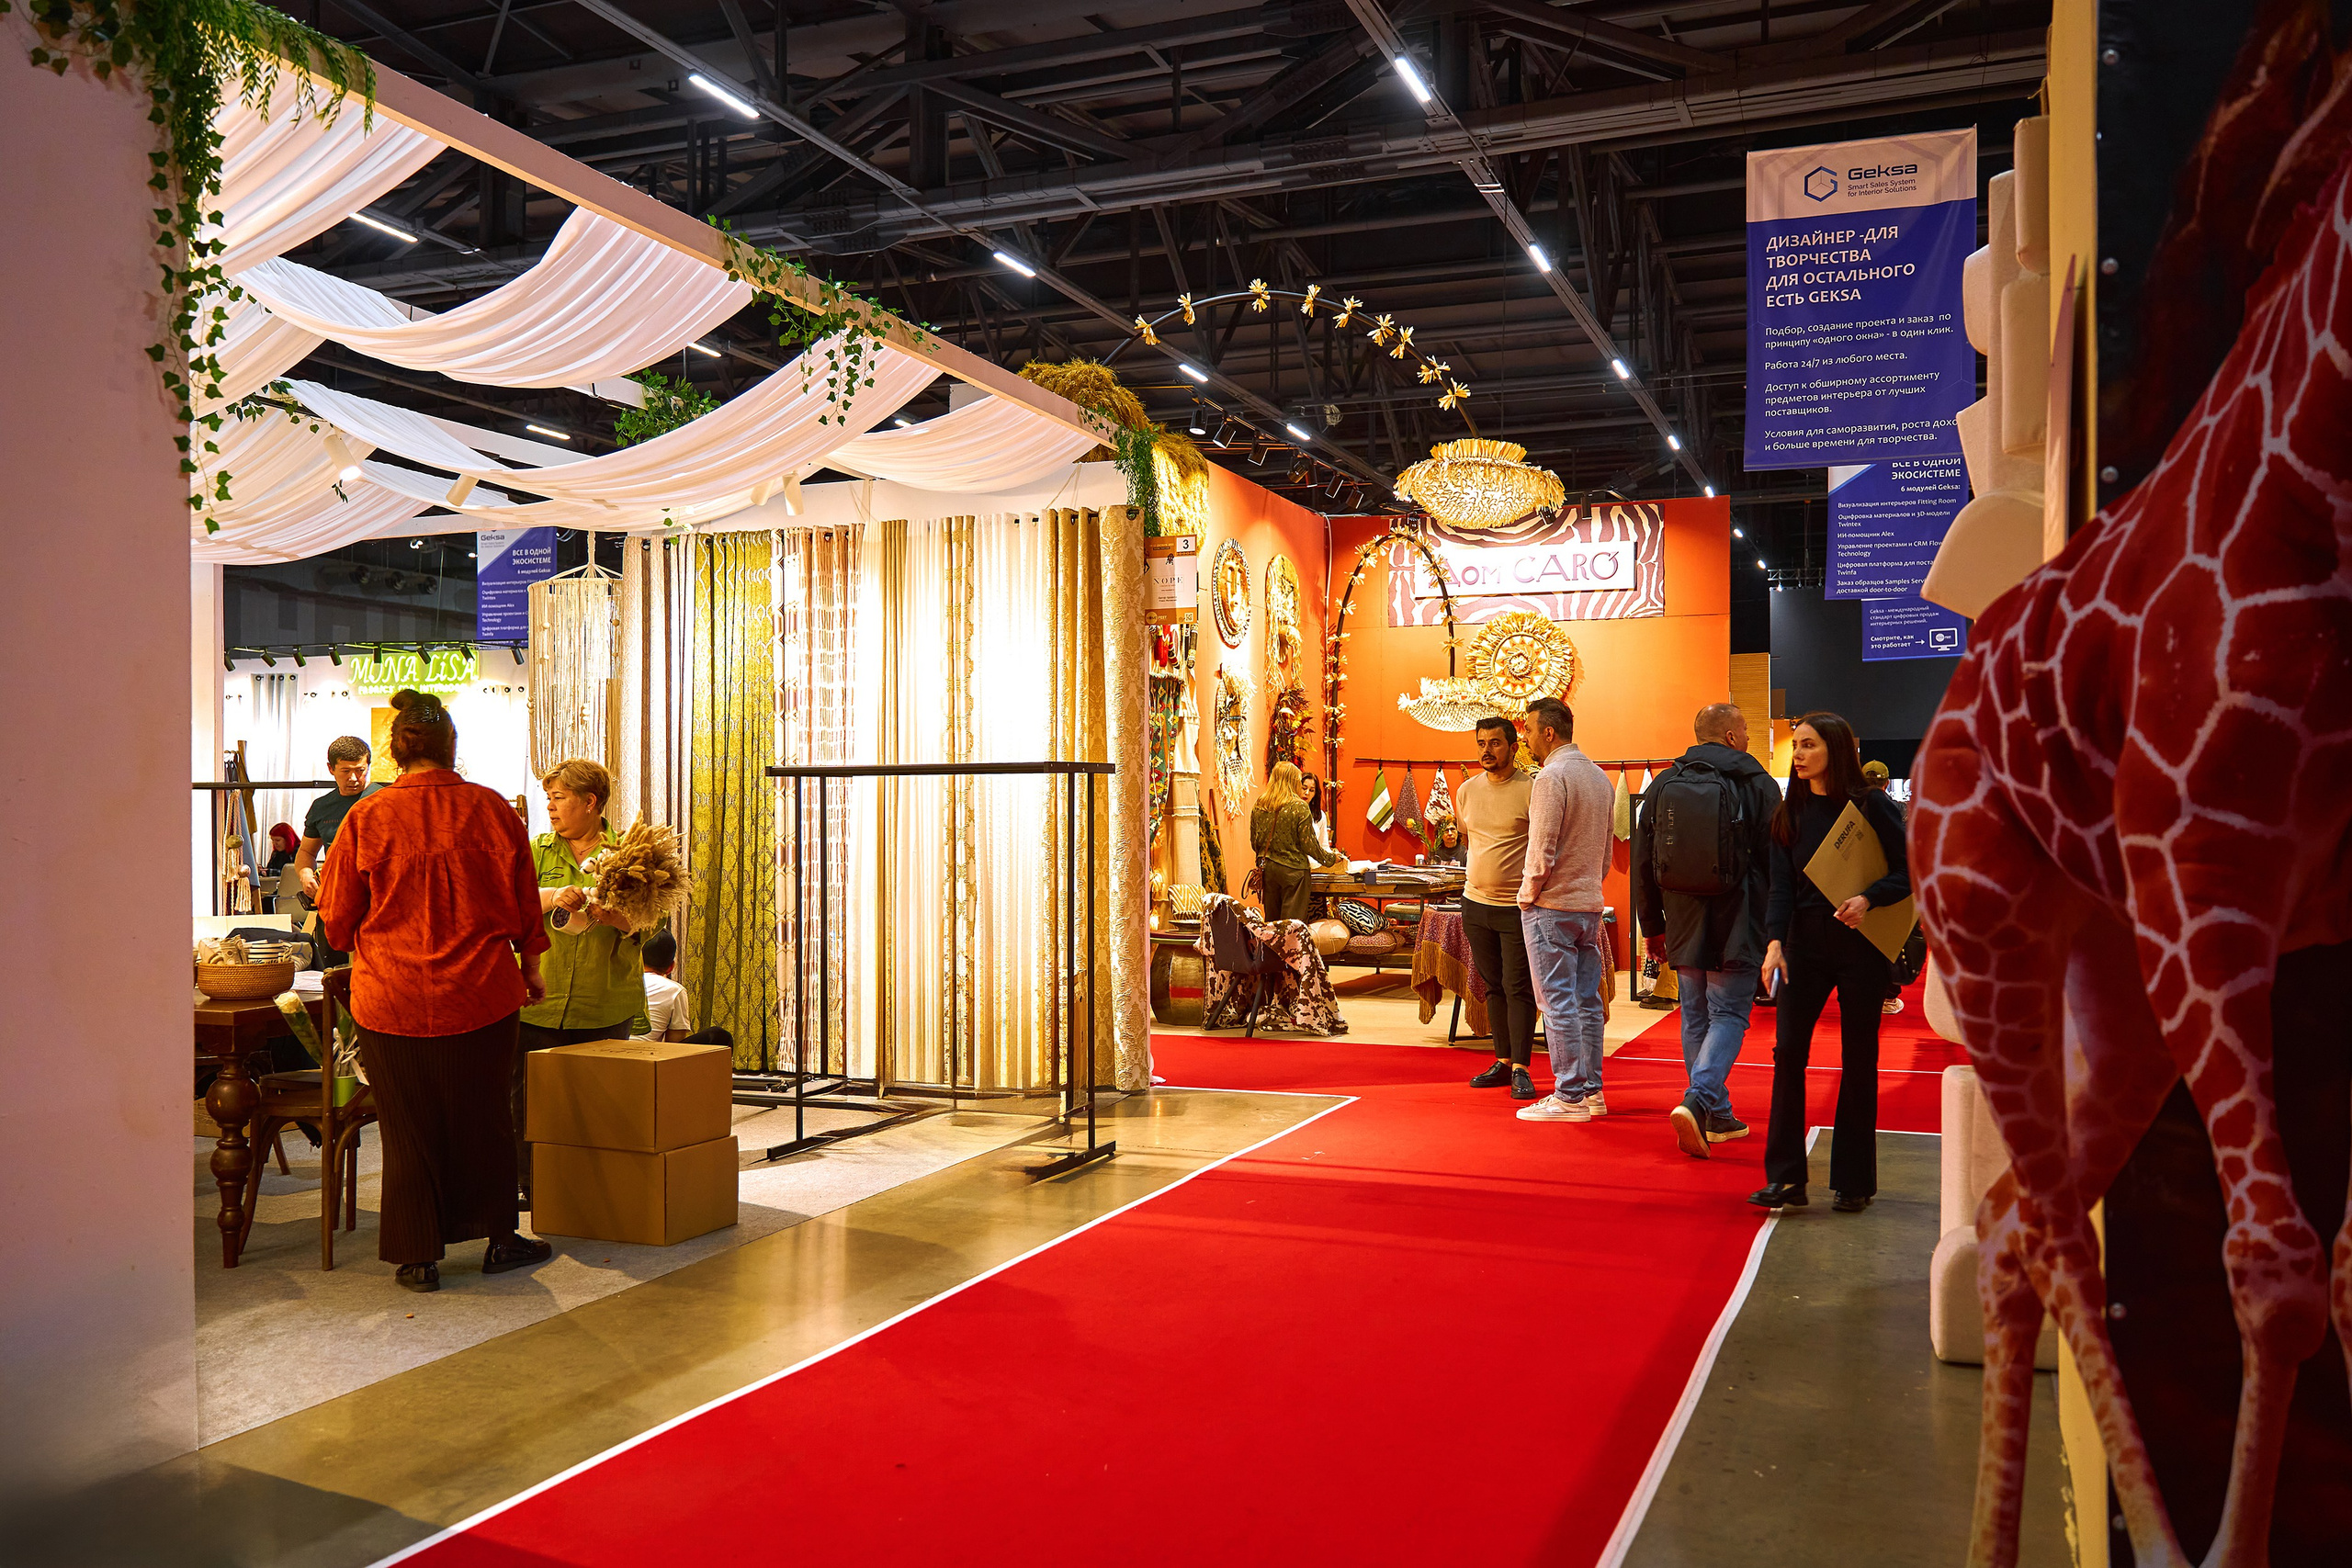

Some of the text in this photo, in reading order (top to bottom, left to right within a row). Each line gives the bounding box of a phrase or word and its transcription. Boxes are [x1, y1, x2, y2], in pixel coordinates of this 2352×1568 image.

[1848, 164, 1918, 180] Geksa
[1848, 183, 1869, 191] Smart
[1890, 178, 1916, 187] System
[1859, 188, 1883, 197] Interior
[1884, 185, 1917, 193] Solutions
[1766, 230, 1856, 254] ДИЗАЙНЕР
[1766, 248, 1871, 269] ТВОРЧЕСТВА
[1765, 263, 1916, 292] ДЛЯ ОСТАЛЬНОГО
[1766, 288, 1861, 308] ЕСТЬ GEKSA
[1765, 327, 1806, 336] Подбор,
[1807, 323, 1854, 333] создание
[1855, 318, 1896, 329] проекта
[1907, 314, 1935, 324] заказ
[1939, 313, 1951, 321] по
[1765, 338, 1810, 350] принципу
[1813, 334, 1853, 344] «одного
[1856, 333, 1884, 341] окна»
[1900, 329, 1926, 338] один
[1928, 326, 1954, 335] клик.
[1764, 360, 1799, 370] Работа
[1801, 358, 1820, 369] 24/7
[1836, 355, 1873, 364] любого
[1875, 353, 1908, 361] места.
[1764, 383, 1799, 394] Доступ
[1809, 377, 1867, 389] обширному
[1869, 371, 1940, 384] ассортименту
[1765, 386, 1926, 406] предметов интерьера от лучших
[1765, 406, 1832, 417] поставщиков.
[1764, 429, 1804, 439] Условия
[1806, 427, 1825, 437] для
[1826, 423, 1899, 435] саморазвития,
[1902, 420, 1930, 430] роста
[1764, 434, 1938, 451] и больше времени для творчества.
[1891, 468, 1961, 479] ЭКОСИСТЕМЕ
[1880, 500, 1917, 508] интерьеров
[1873, 512, 1911, 520] материалов
[1917, 510, 1951, 518] 3D-модели
[1182, 538, 1189, 549] 3
[513, 557, 551, 566] ЭКОСИСТЕМЕ
[1869, 585, 1908, 593] door-to-door
[1885, 578, 1910, 586] Samples
[1882, 641, 1911, 649] работает
[348, 656, 420, 684] MONA
[1834, 820, 1856, 851] DERUFA
